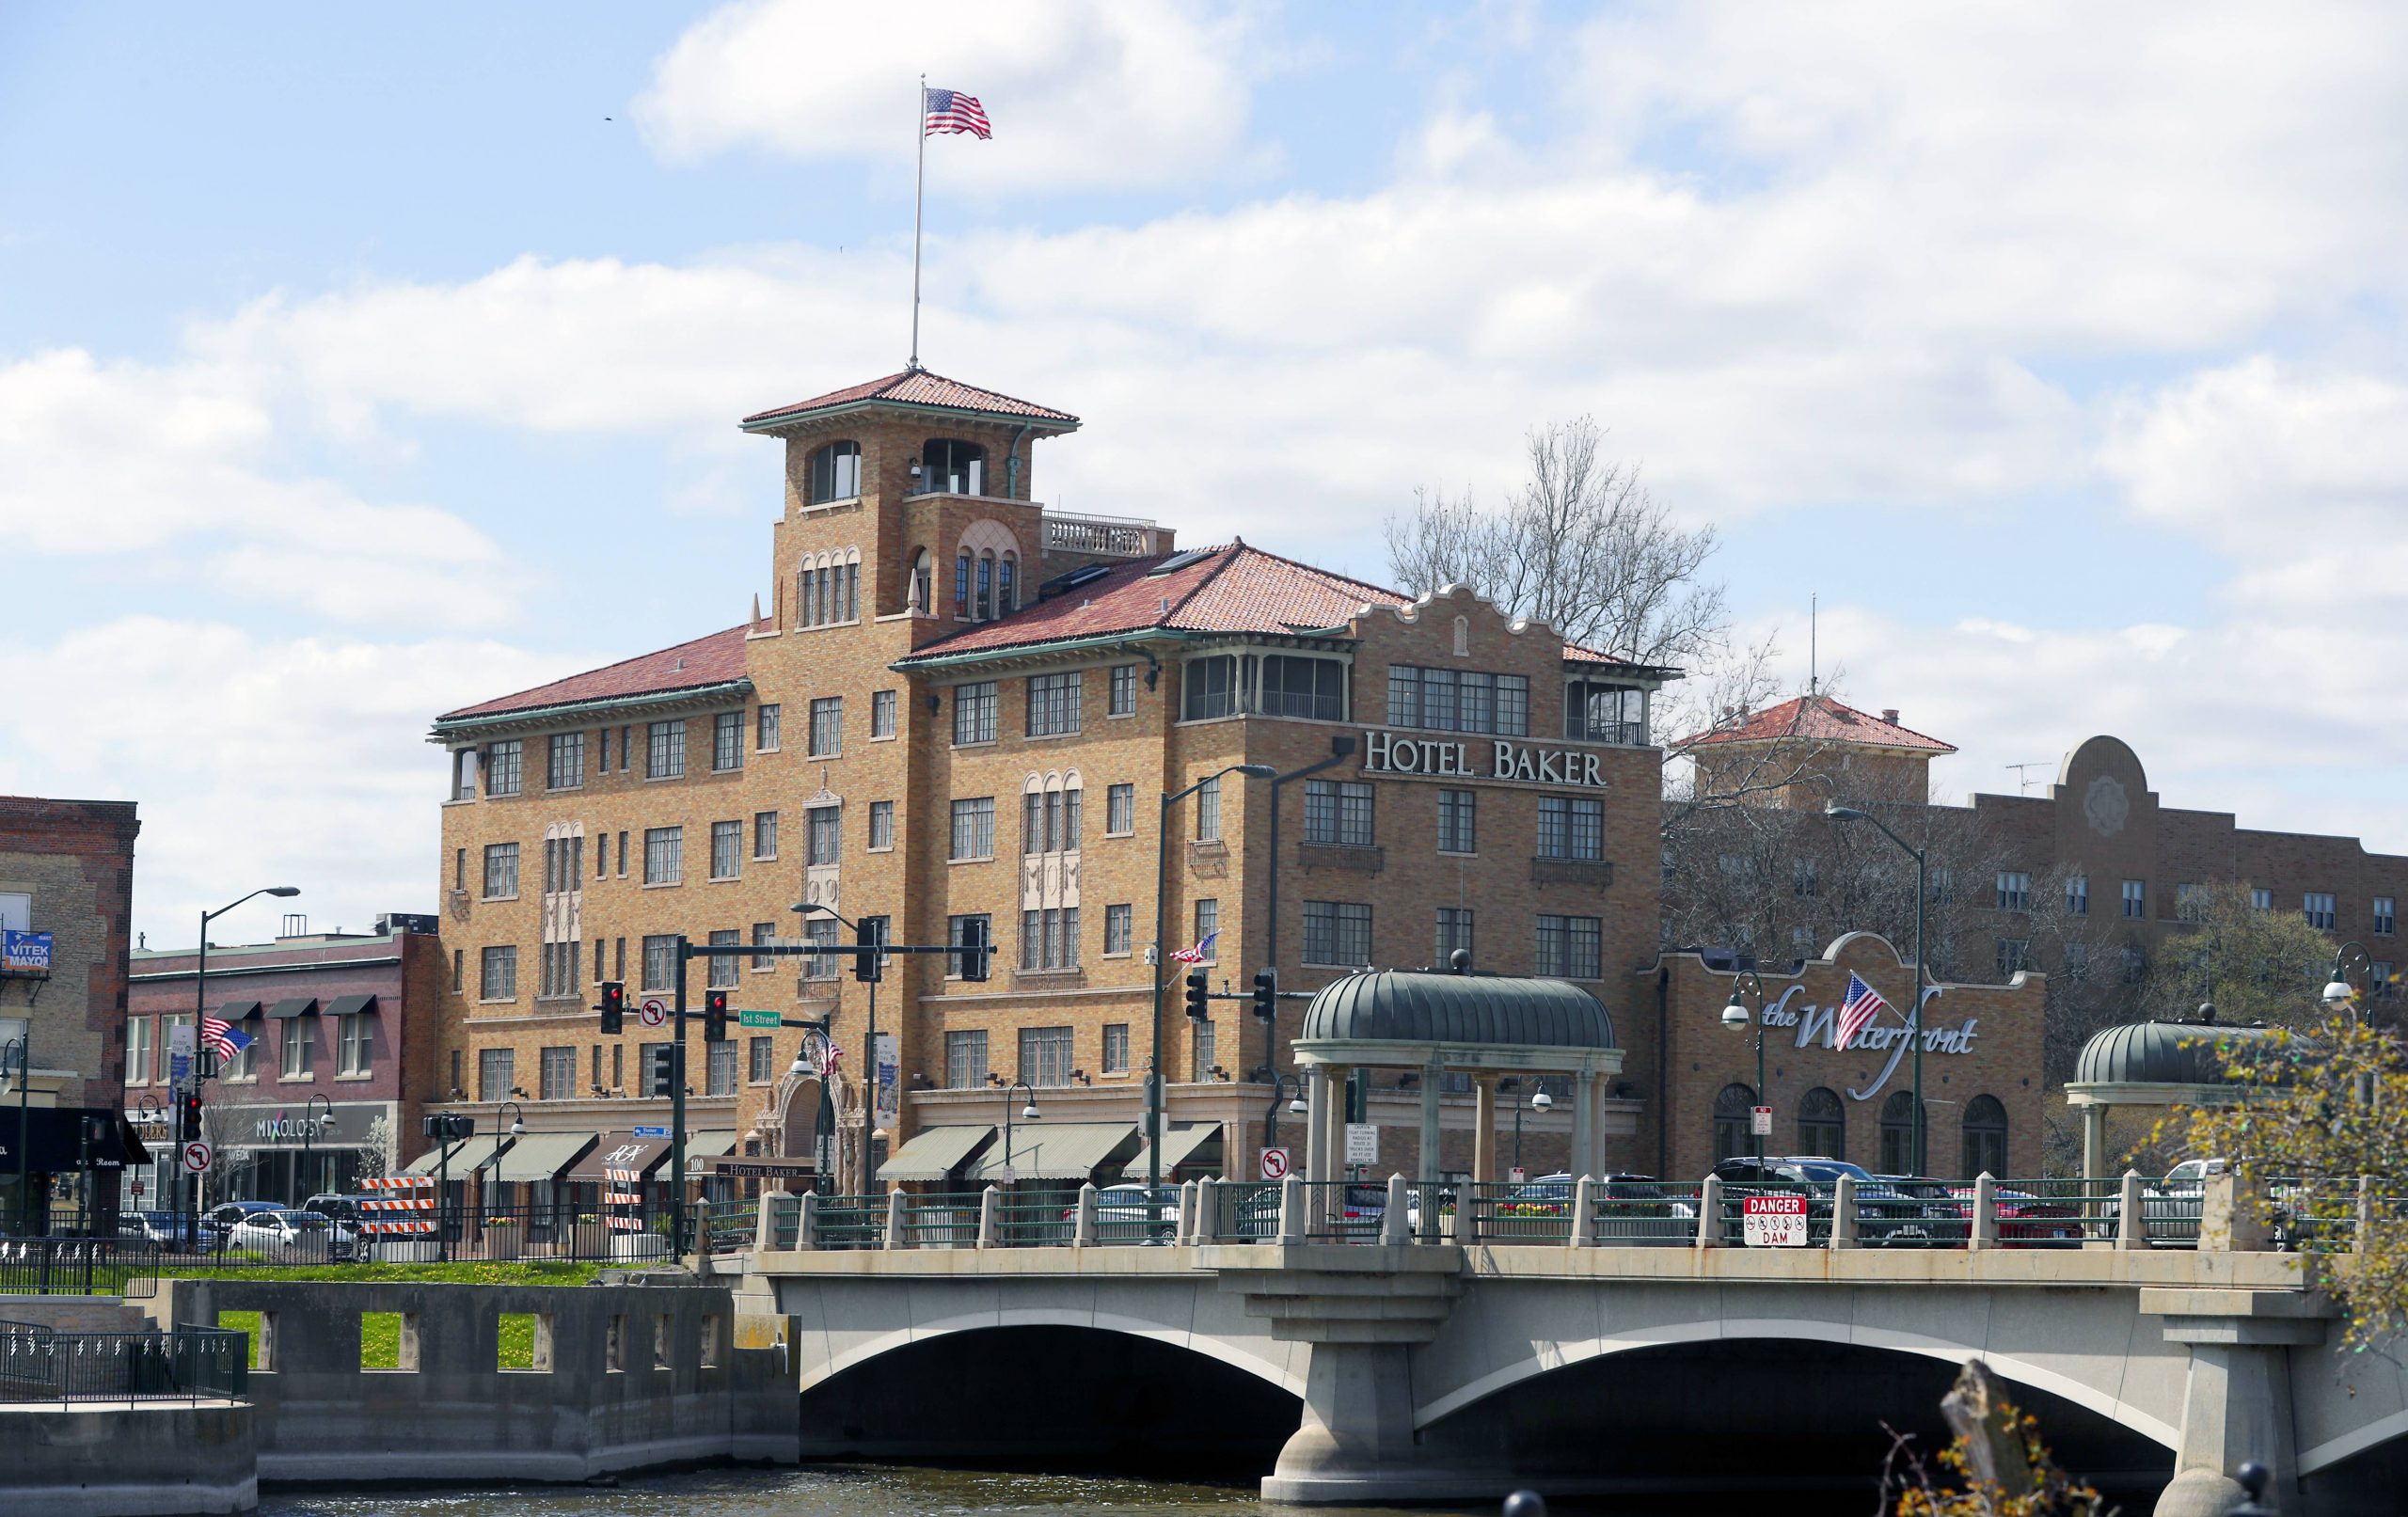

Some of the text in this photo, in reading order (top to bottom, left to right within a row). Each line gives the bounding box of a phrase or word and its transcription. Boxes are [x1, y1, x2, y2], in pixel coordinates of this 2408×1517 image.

[1365, 732, 1607, 785] HOTEL BAKER
[10, 942, 49, 956] VITEK
[9, 956, 49, 968] MAYOR
[743, 1014, 777, 1024] 1st Street
[1763, 986, 1978, 1101] the Wterfront
[256, 1109, 321, 1143] MIXOLOGY
[818, 1138, 833, 1147] JT
[96, 1158, 120, 1166] Room
[690, 1158, 705, 1172] 100
[730, 1165, 798, 1177] HOTEL BAKER
[1751, 1199, 1799, 1213] DANGER
[1763, 1232, 1788, 1244] DAM
